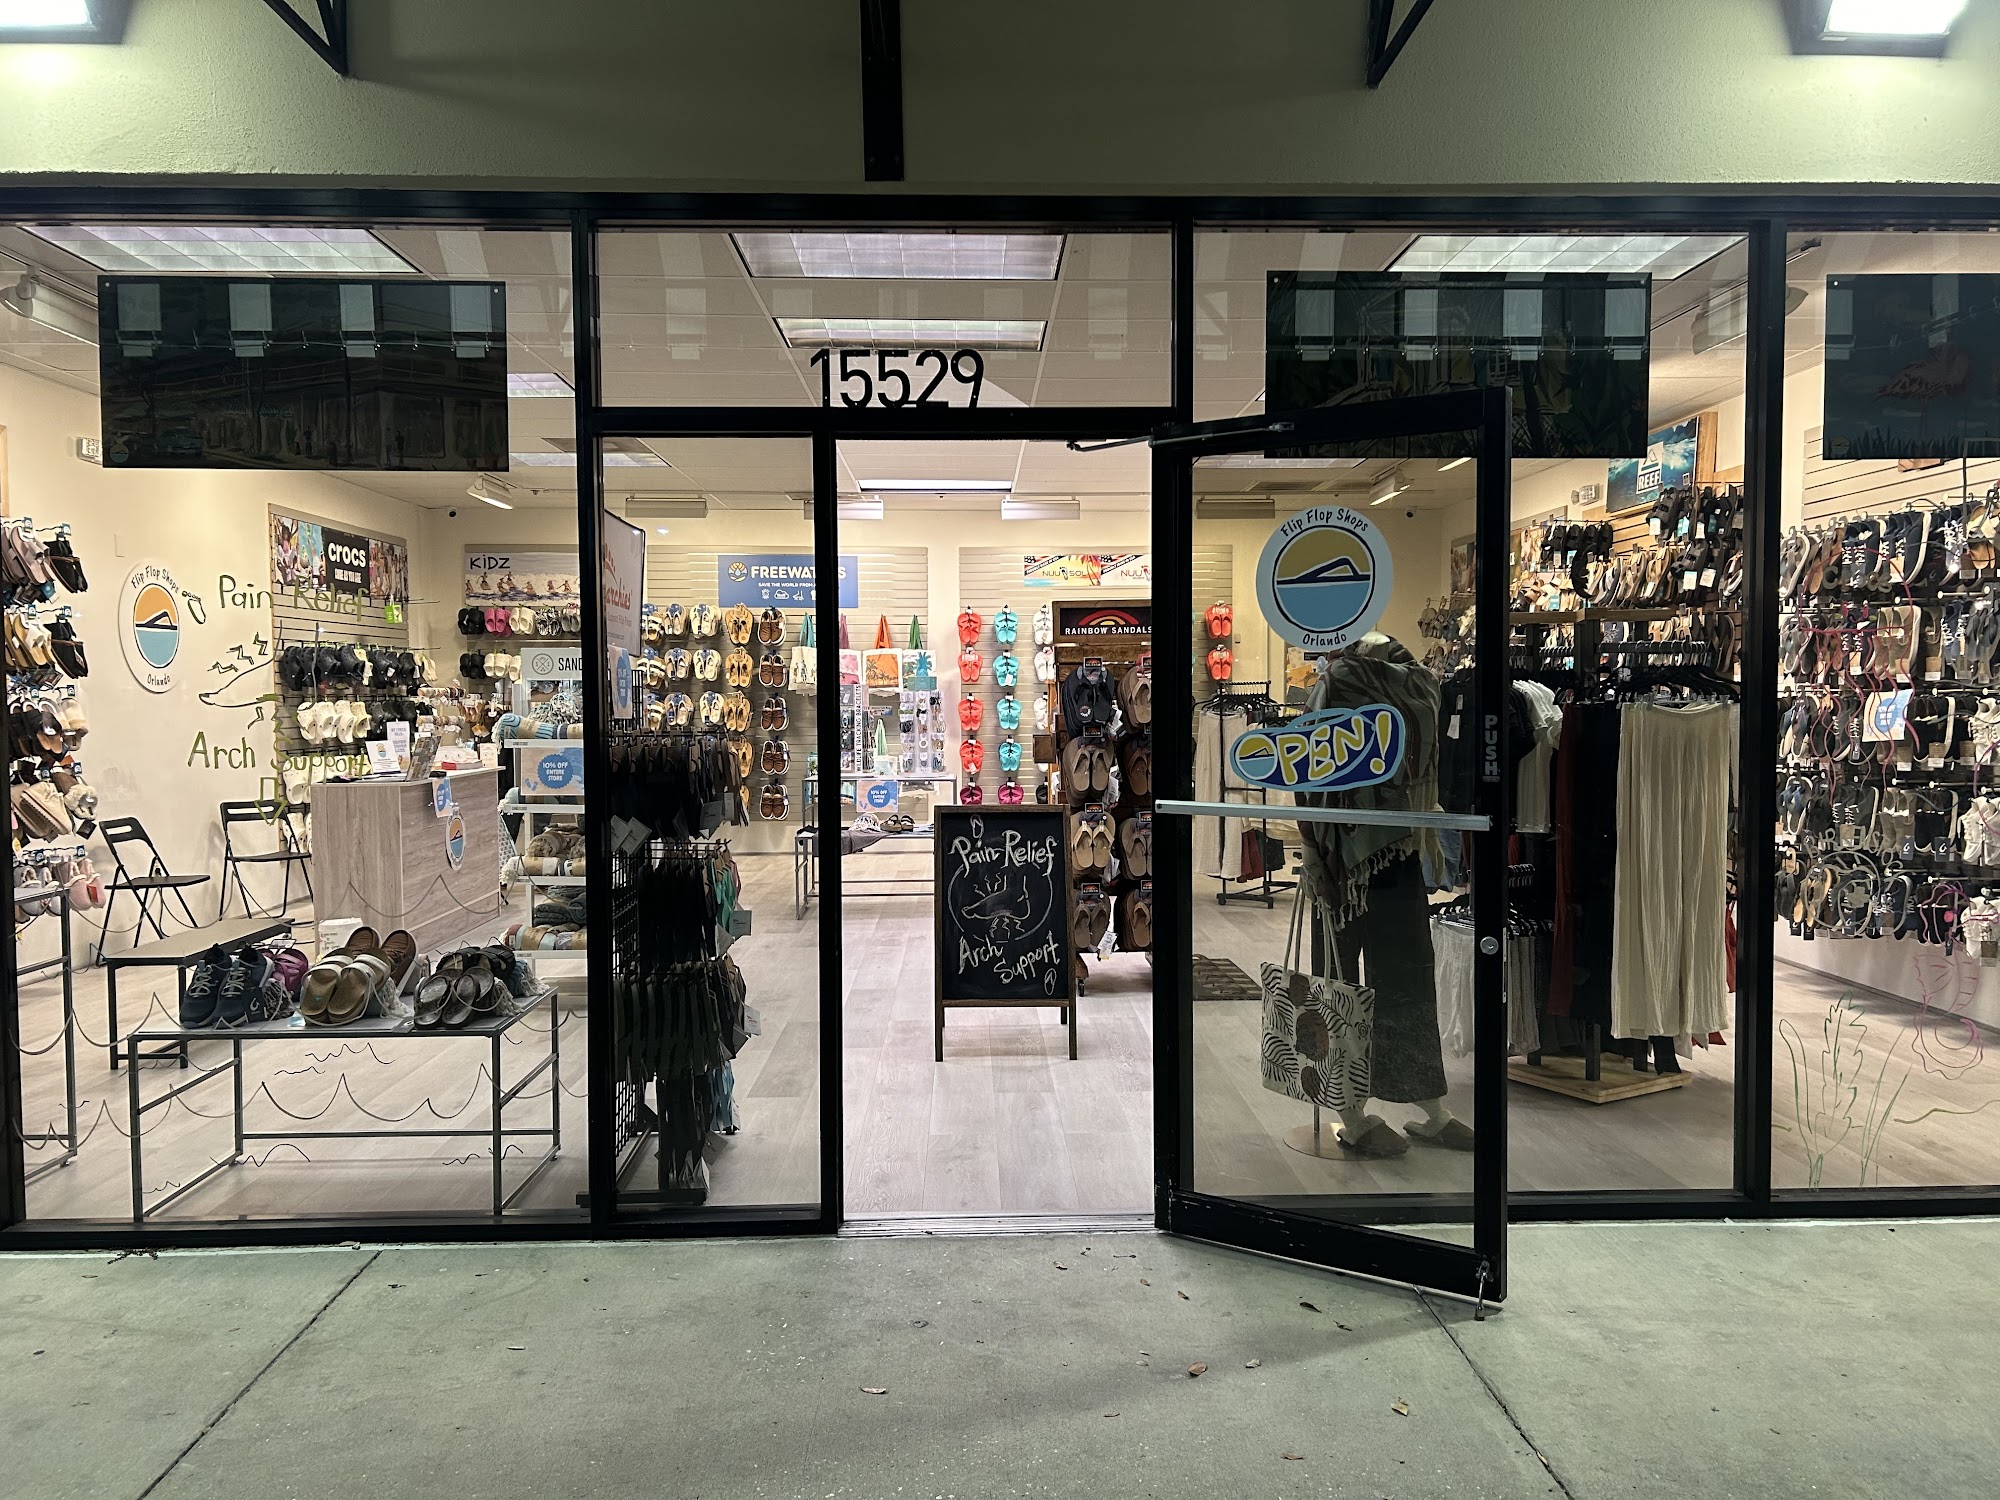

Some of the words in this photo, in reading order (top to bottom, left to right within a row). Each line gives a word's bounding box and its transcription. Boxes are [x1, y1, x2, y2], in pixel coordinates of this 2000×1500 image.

[810, 348, 984, 408] 15529
[1638, 471, 1659, 490] REEF
[1280, 518, 1303, 537] Flip
[1306, 509, 1333, 524] Flop
[1337, 508, 1369, 532] Shops
[328, 542, 366, 567] crocs
[130, 572, 145, 589] Flip
[145, 565, 161, 581] Flop
[161, 568, 180, 594] Shops
[751, 565, 846, 579] FREEWATS
[219, 574, 273, 609] Pain
[293, 575, 369, 621] Relief
[1065, 627, 1108, 635] RAINBOW
[1111, 626, 1152, 634] SANDALS
[1302, 631, 1347, 647] Orlando
[146, 673, 171, 686] Orlando
[187, 730, 256, 769] Arch
[270, 737, 367, 785] Support
[1484, 714, 1498, 776] PUSH
[948, 836, 1001, 878] Pain
[1000, 829, 1059, 877] Relief
[958, 934, 1004, 974] Arch
[993, 930, 1061, 984] Support
